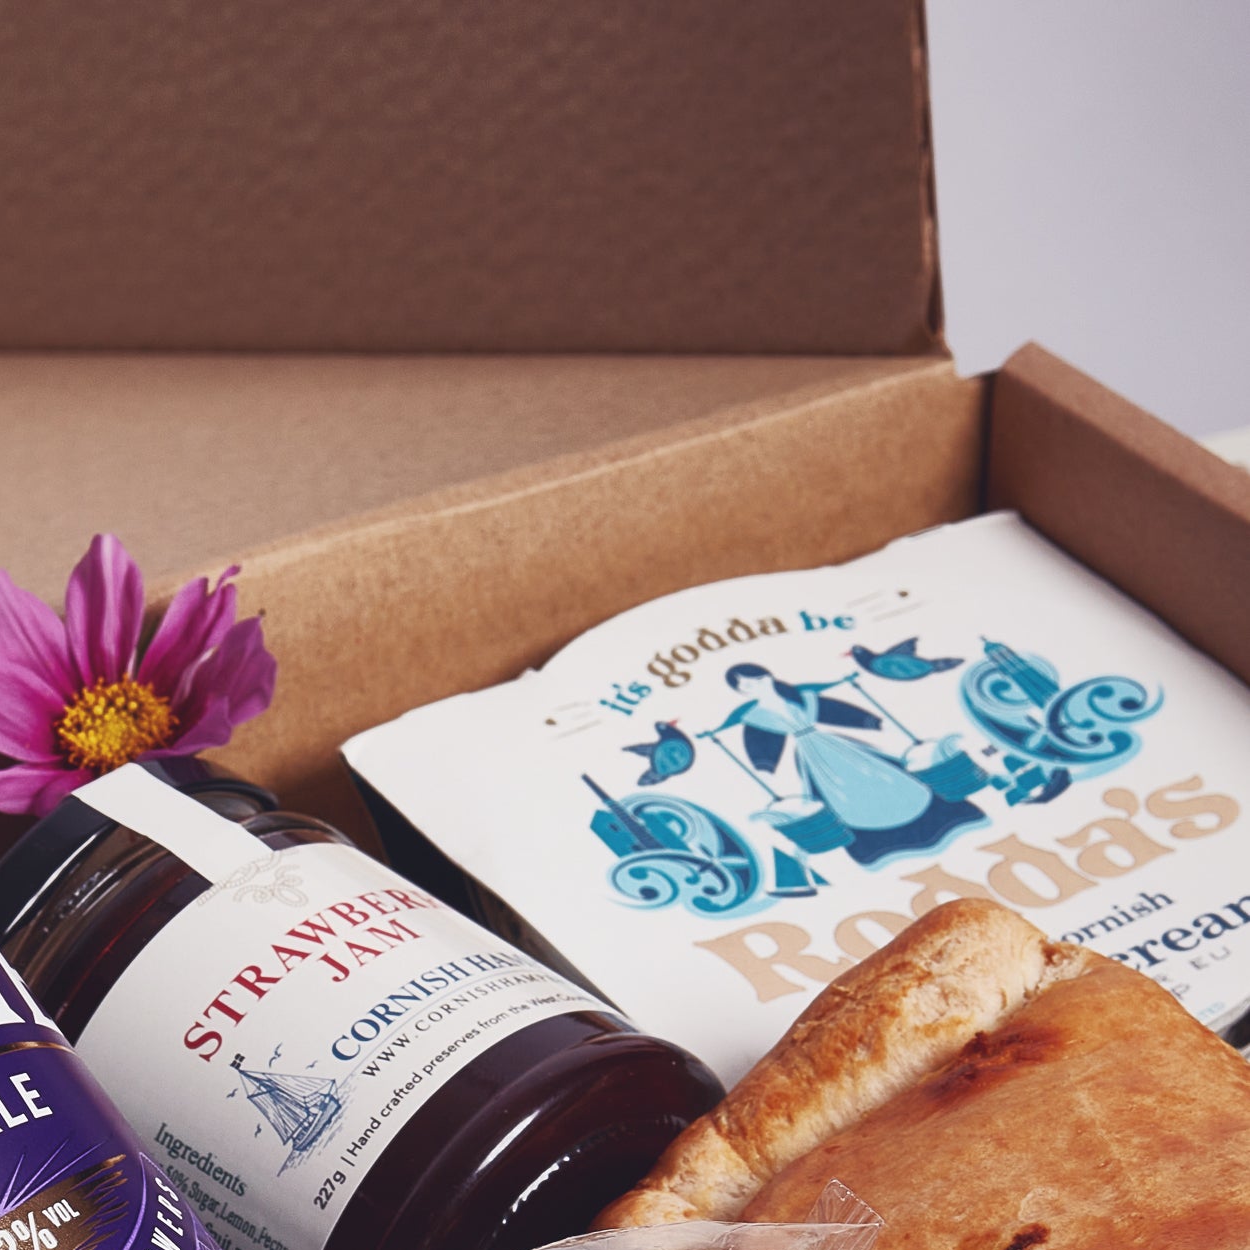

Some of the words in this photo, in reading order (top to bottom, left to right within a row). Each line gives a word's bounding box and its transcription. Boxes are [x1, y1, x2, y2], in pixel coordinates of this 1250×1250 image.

[599, 680, 652, 716] it's
[646, 615, 788, 688] godda
[799, 610, 856, 632] be
[317, 919, 422, 982] JAM
[1060, 893, 1174, 945] ornish
[332, 962, 472, 1061] CORNISH
[314, 1170, 346, 1210] 227g
[347, 1116, 381, 1157] Hand
[380, 1072, 423, 1118] crafted
[423, 1028, 480, 1075] preserves
[477, 1010, 510, 1031] from
[154, 1122, 248, 1197] Ingredients
[42, 1198, 80, 1228] VOL
